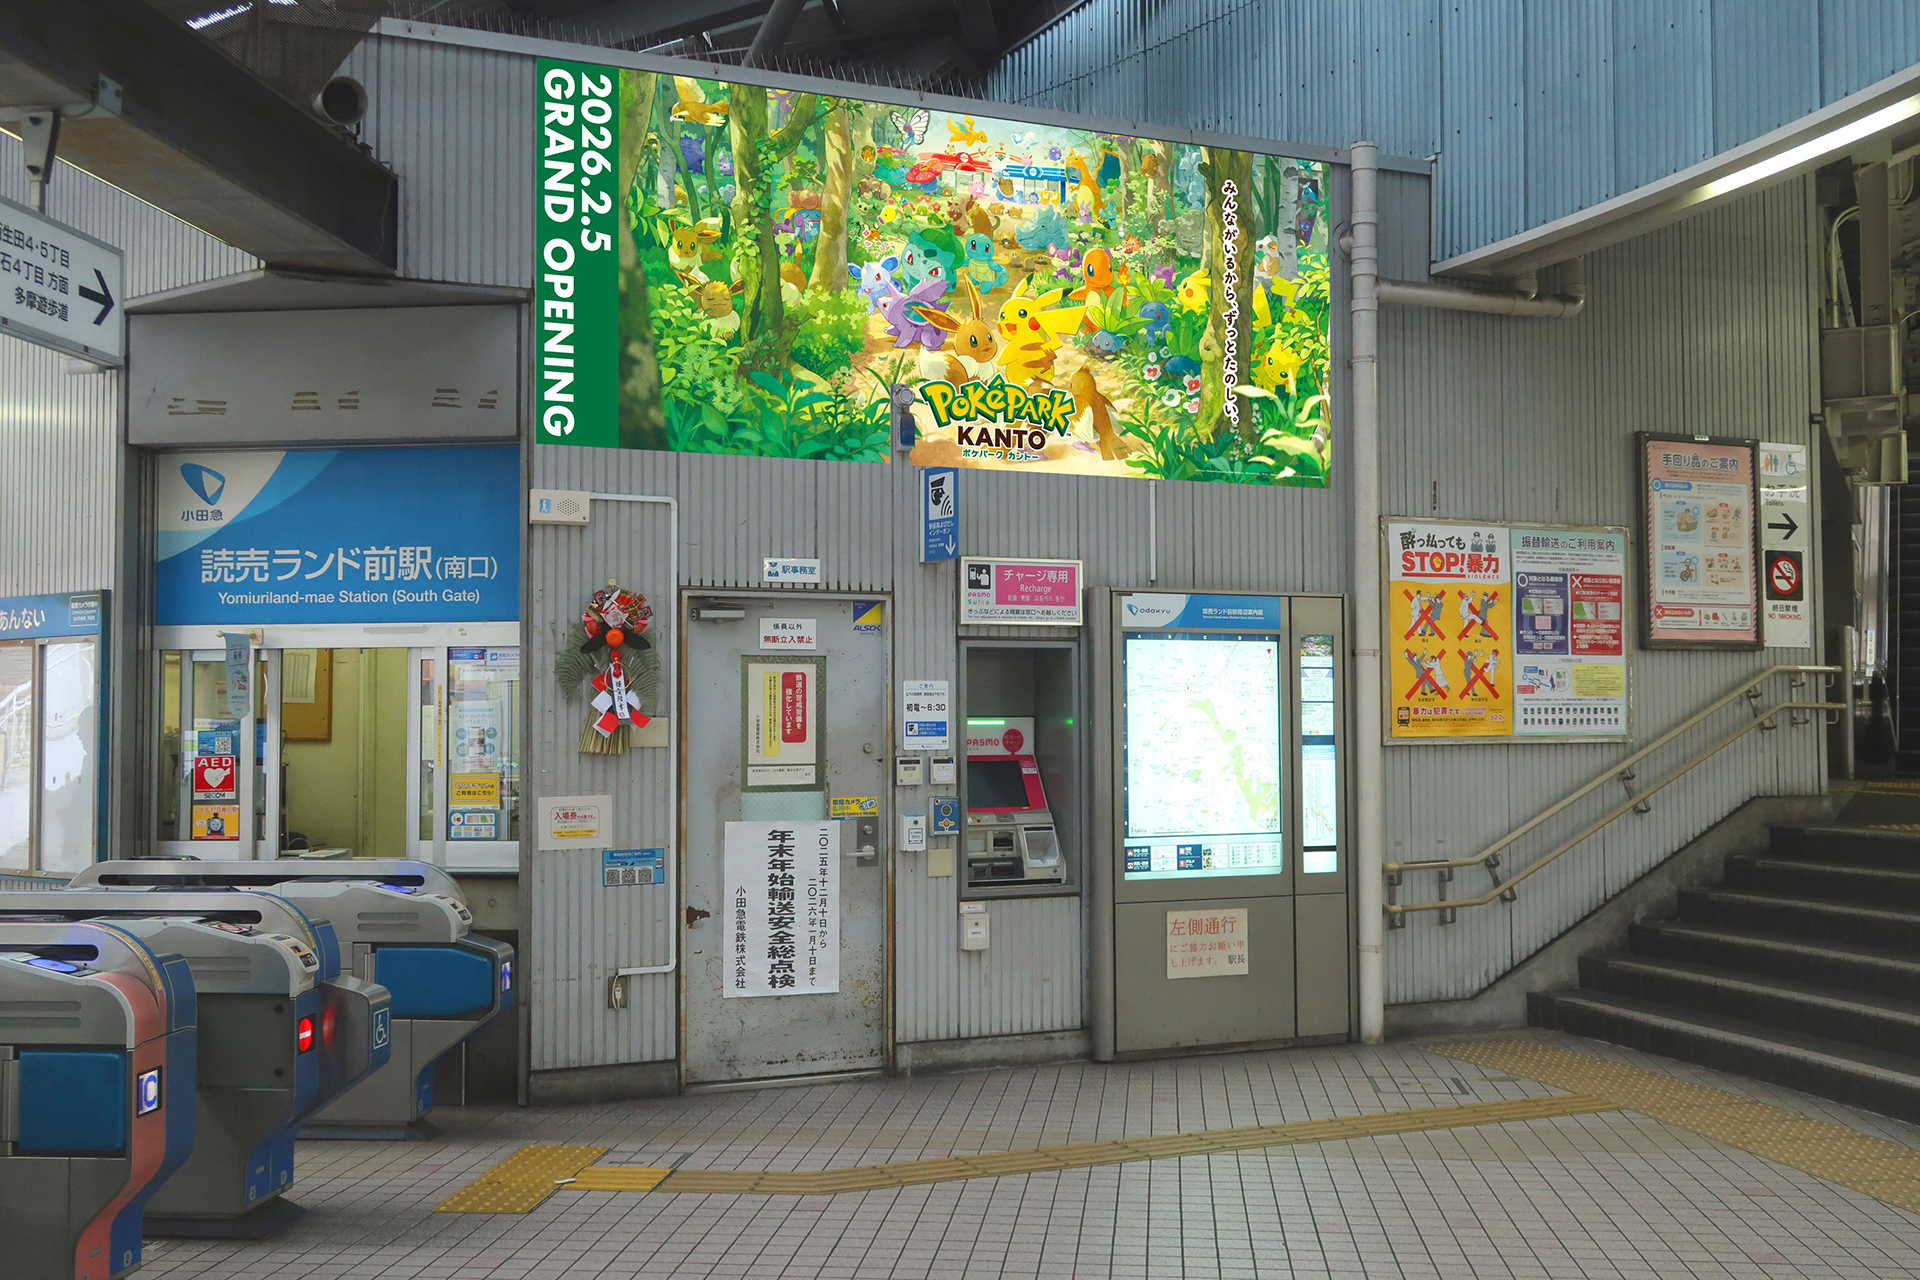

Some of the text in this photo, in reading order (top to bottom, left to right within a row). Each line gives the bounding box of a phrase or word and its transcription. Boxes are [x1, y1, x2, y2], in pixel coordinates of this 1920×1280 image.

[581, 72, 612, 252] 2026.2.5
[543, 68, 575, 437] GRAND OPENING
[48, 271, 69, 296] 方面
[14, 286, 68, 322] 多摩遊歩道
[1223, 180, 1238, 424] みんながいるから、ずっとたのしい。
[957, 425, 1046, 450] KANTO
[962, 449, 1039, 461] ポケパーク カントー
[1662, 453, 1739, 471] 手回り品のご案内
[181, 509, 224, 522] 小田急
[1400, 530, 1466, 550] 酔っ払っても
[1522, 536, 1615, 552] 振替輸送のご利用案内
[781, 565, 816, 576] 駅事務室
[1004, 569, 1068, 584] チャージ専用
[218, 588, 480, 604] Yomiuriland-mae Station (South Gate)
[1020, 584, 1052, 594] Recharge
[1772, 604, 1798, 612] 終日禁煙
[764, 636, 813, 644] 無断立入禁止
[1413, 707, 1461, 716] 暴力は犯罪です。
[198, 757, 232, 767] AED
[768, 830, 796, 989] 年末年始輸送安全総点検
[1170, 916, 1237, 936] 左側通行
[735, 886, 746, 989] 小田急電鉄株式会社
[1170, 940, 1245, 953] にご協力お願い申
[1171, 954, 1246, 968] し上げます。 駅長
[138, 1074, 158, 1113] IC
